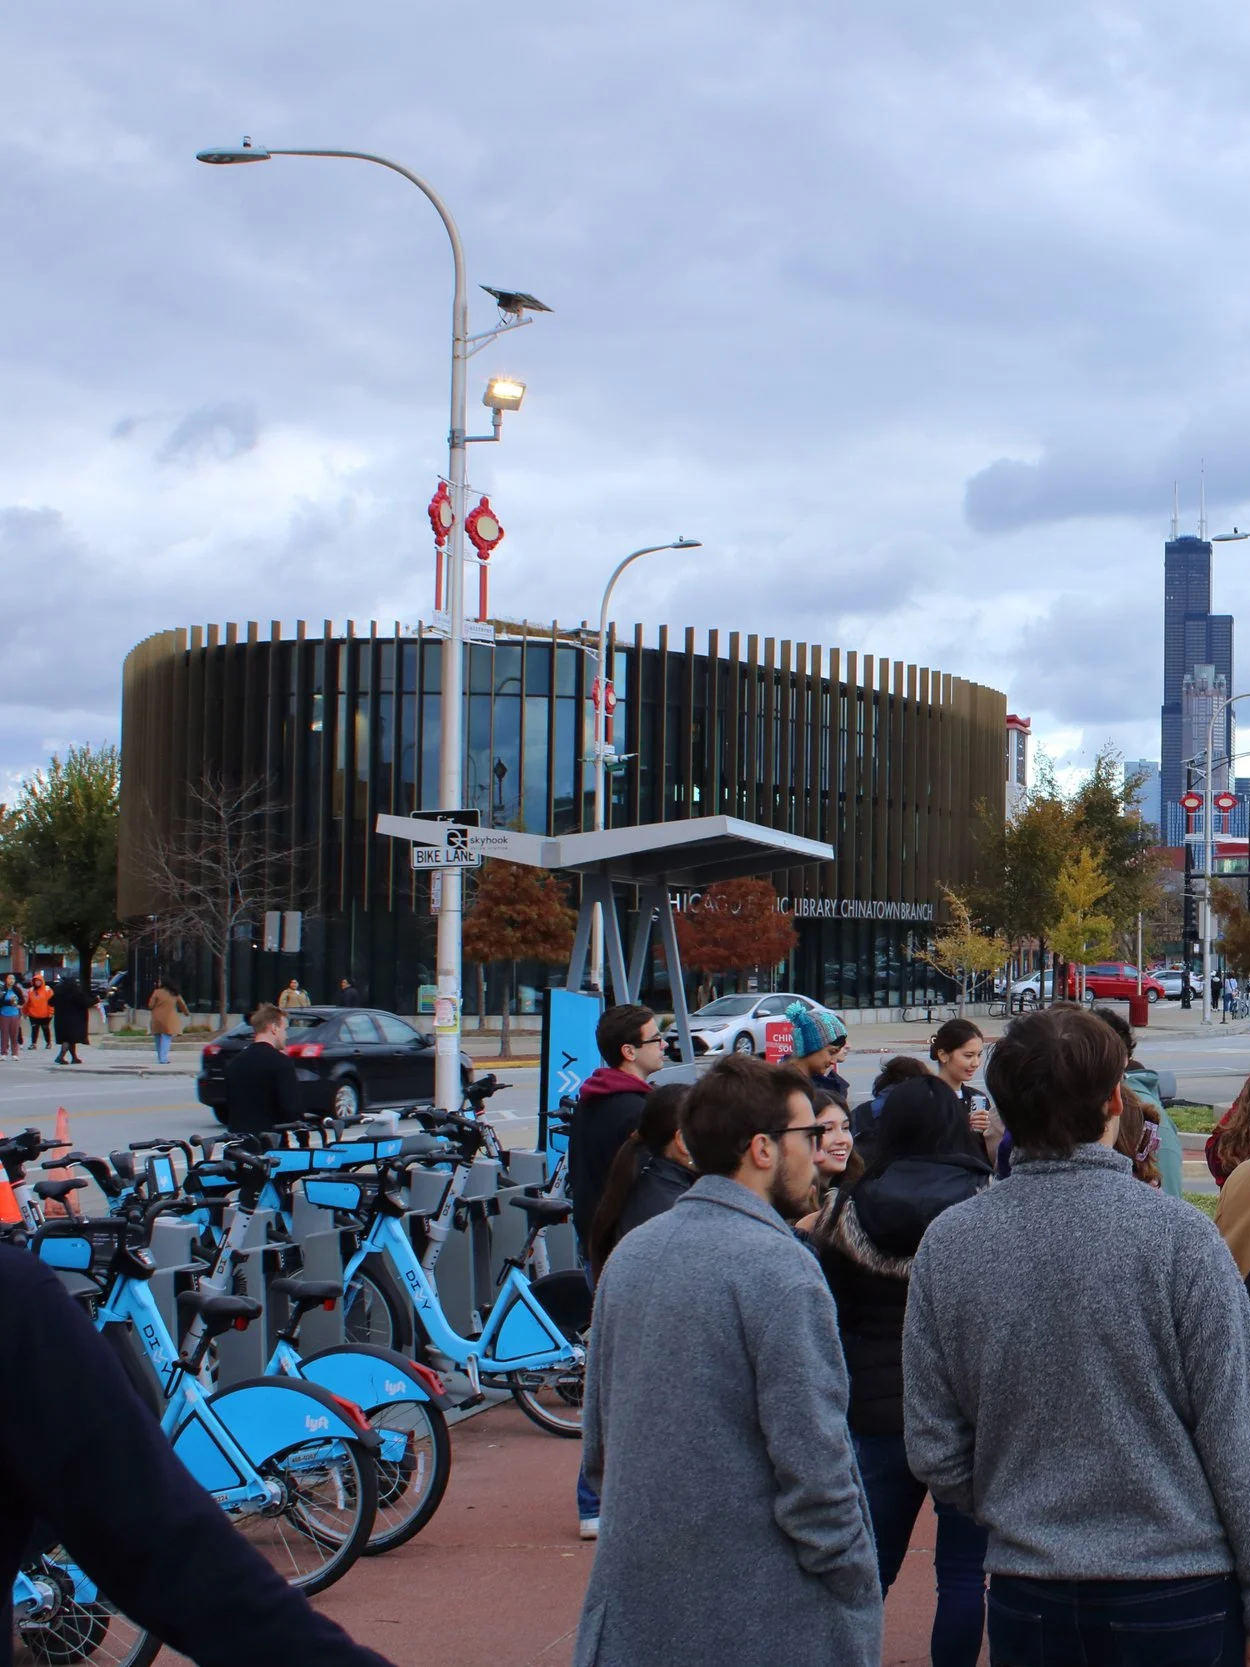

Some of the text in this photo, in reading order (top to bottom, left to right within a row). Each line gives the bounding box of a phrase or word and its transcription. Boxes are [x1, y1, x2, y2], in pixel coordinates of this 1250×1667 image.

[470, 836, 508, 845] skyhook
[417, 849, 475, 863] BIKE LANE
[794, 897, 837, 917] LIBRARY
[840, 899, 901, 919] CHINATOWN
[901, 902, 933, 920] BRANCH
